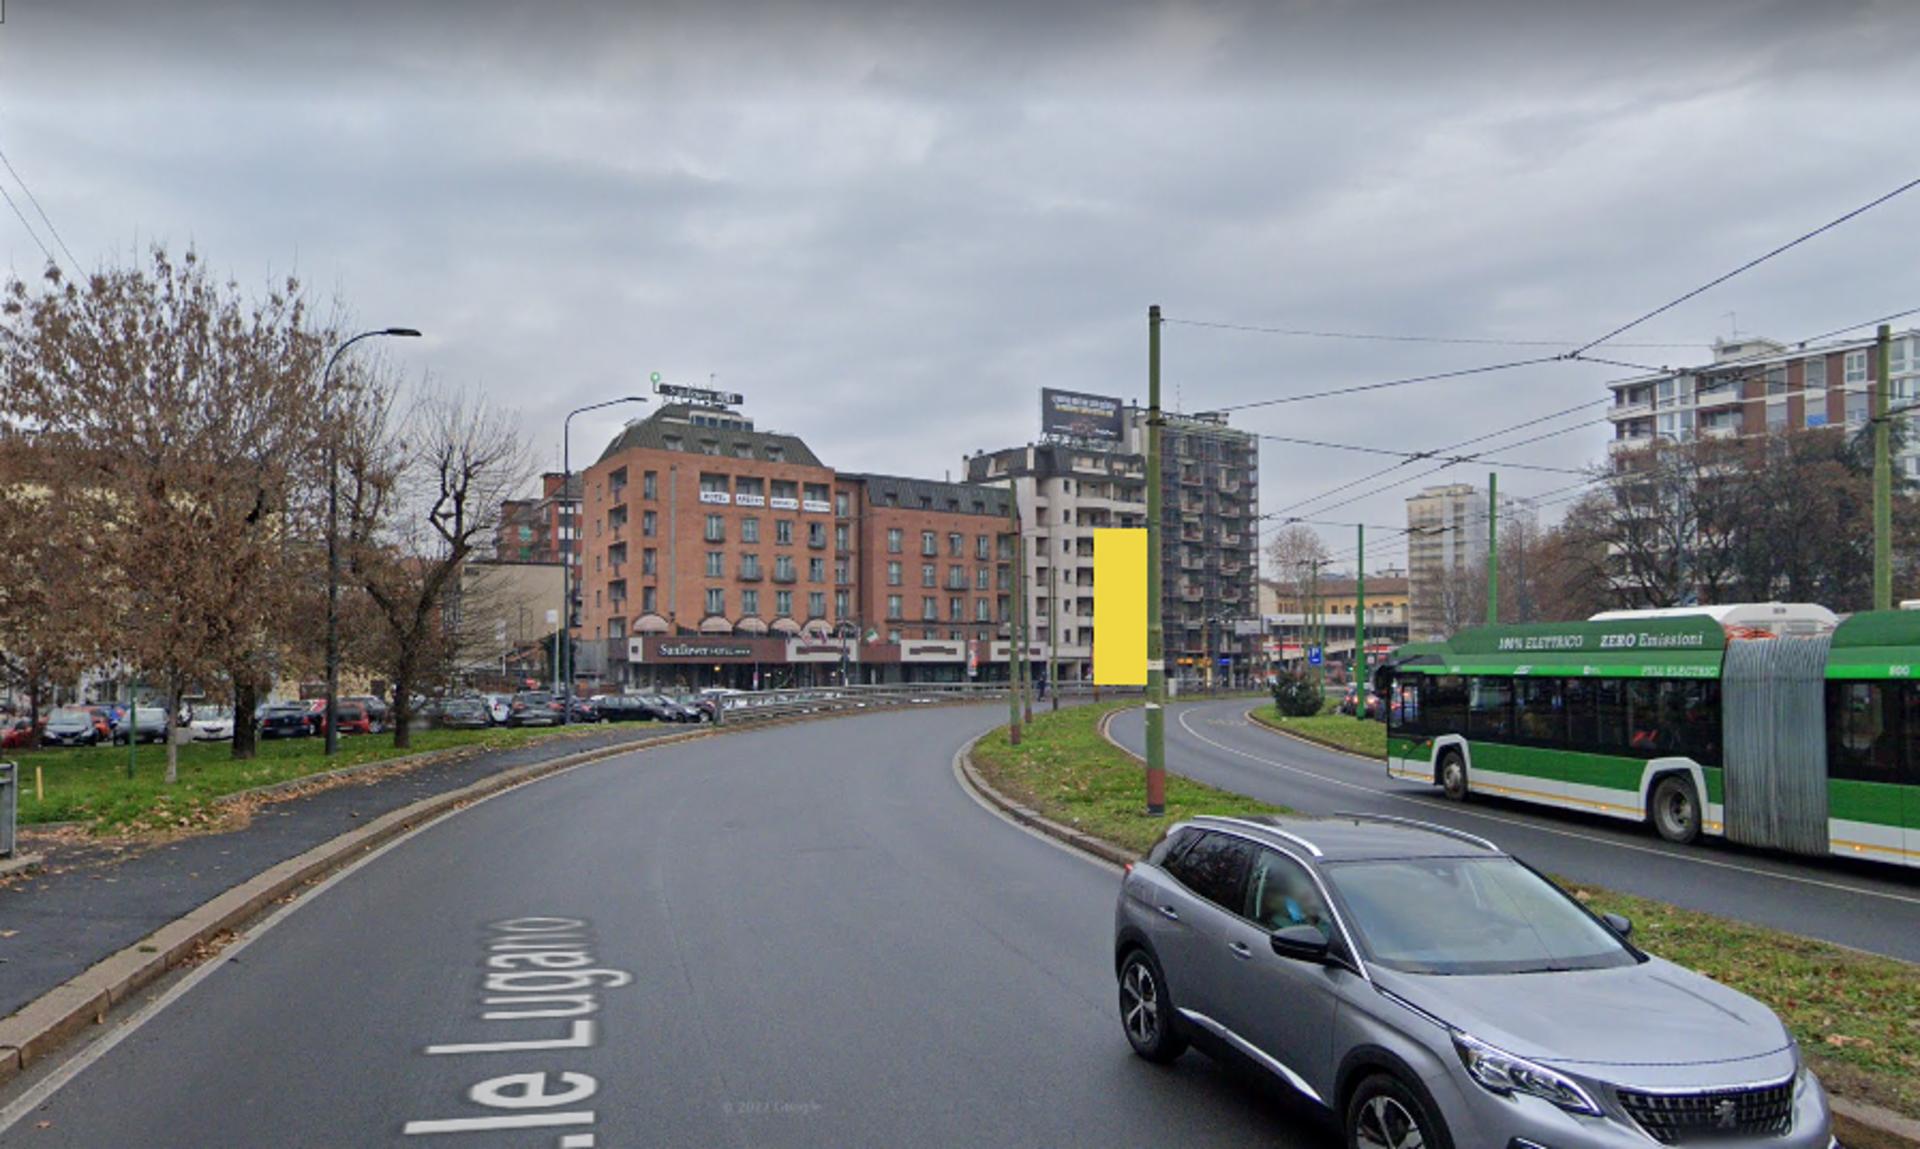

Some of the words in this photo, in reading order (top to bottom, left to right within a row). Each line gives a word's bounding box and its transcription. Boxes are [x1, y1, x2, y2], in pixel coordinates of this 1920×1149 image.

[1499, 637, 1523, 650] 100%
[1525, 635, 1583, 649] ELETTRICO
[1600, 633, 1636, 648] ZERO
[1639, 631, 1704, 647] Emissioni
